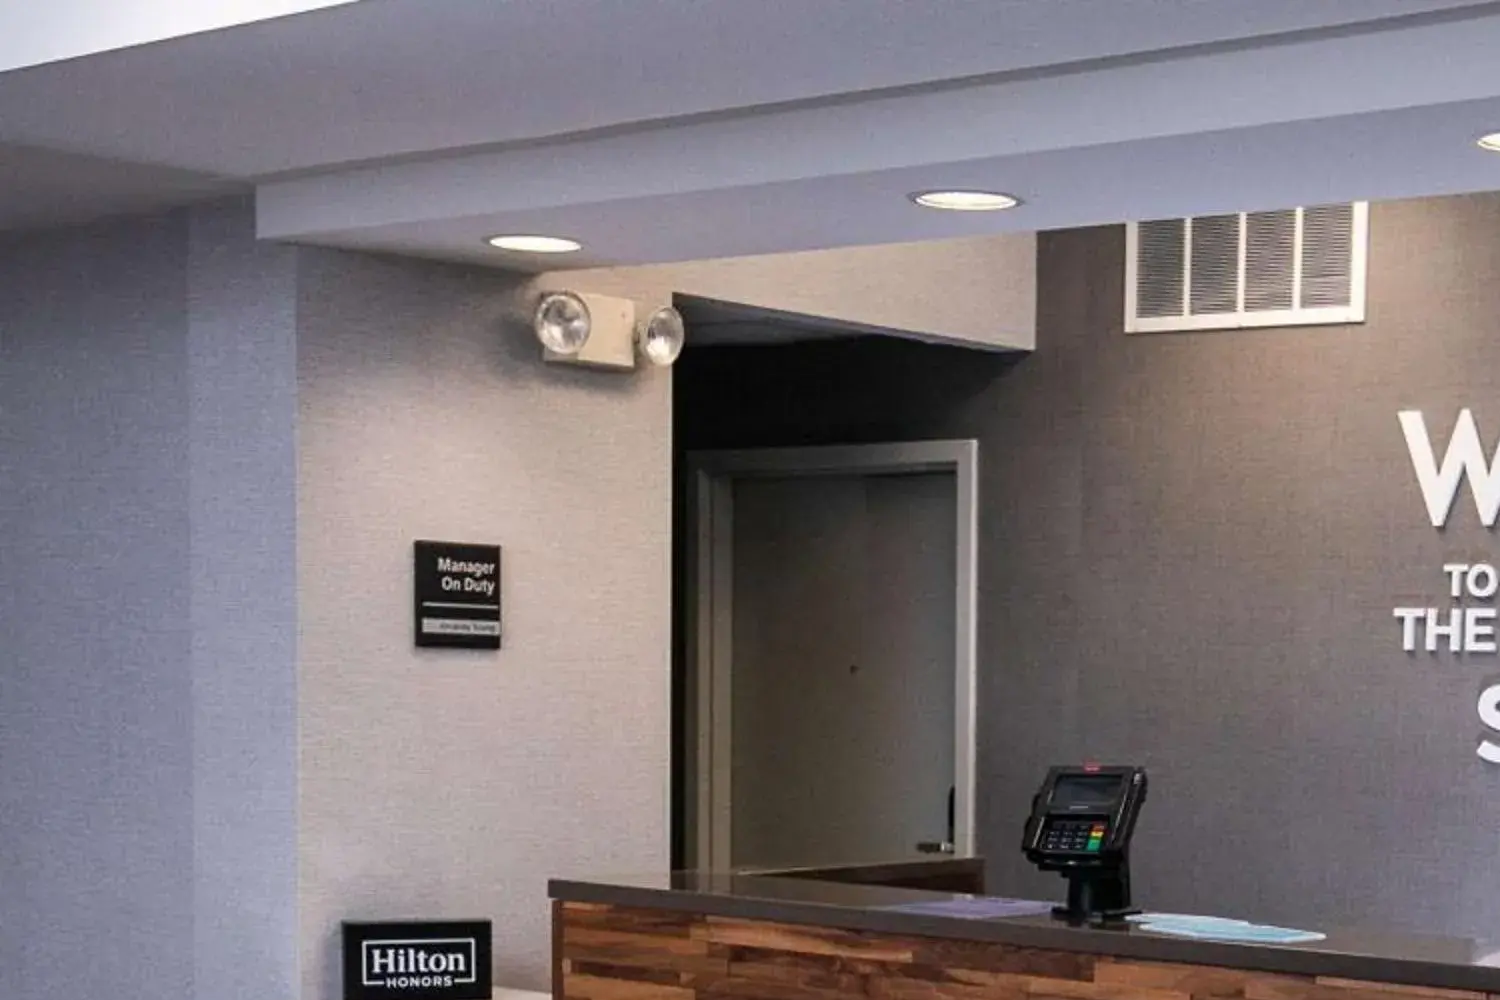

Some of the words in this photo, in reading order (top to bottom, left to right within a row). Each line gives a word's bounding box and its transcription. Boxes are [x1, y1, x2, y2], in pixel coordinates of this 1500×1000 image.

[437, 557, 496, 578] Manager
[441, 576, 461, 592] On
[464, 577, 495, 597] Duty
[1443, 563, 1498, 597] TO
[1393, 607, 1498, 653] THE
[372, 948, 466, 974] Hilton
[386, 975, 453, 989] HONORS
